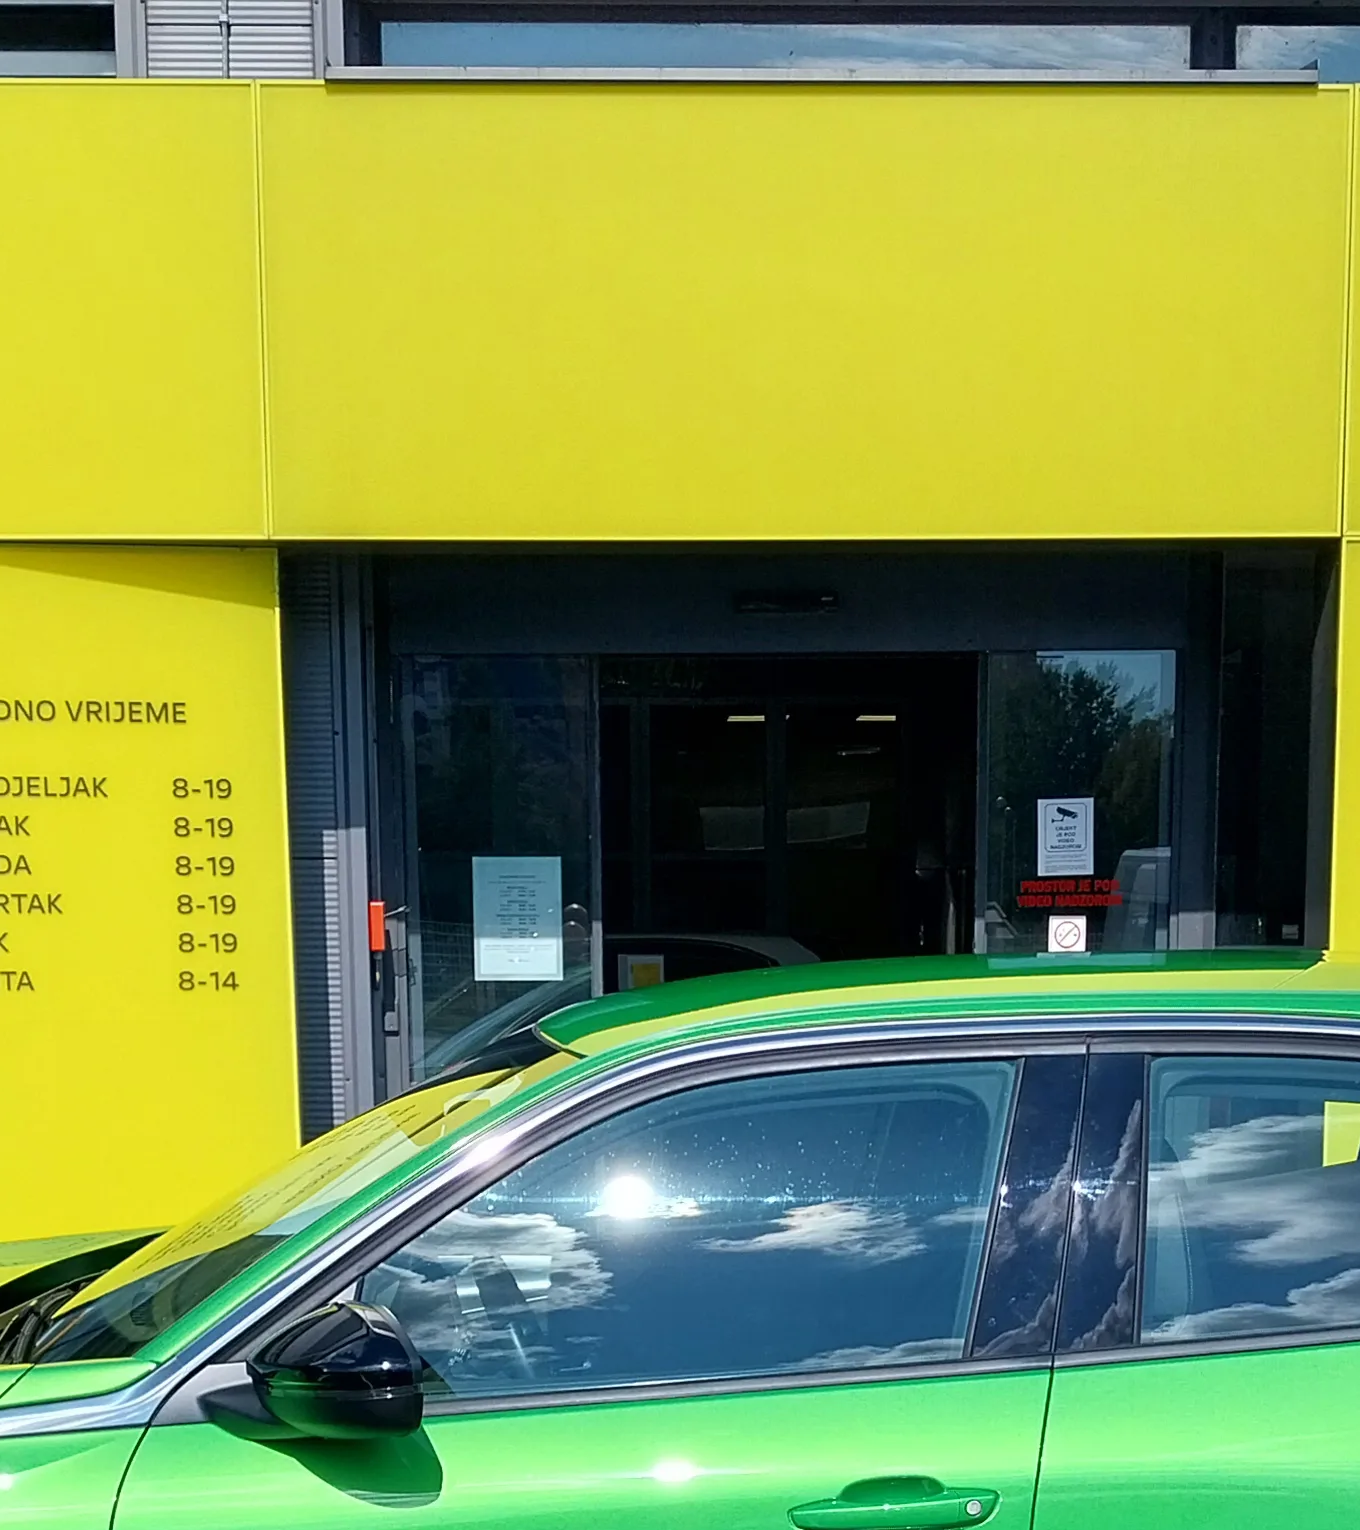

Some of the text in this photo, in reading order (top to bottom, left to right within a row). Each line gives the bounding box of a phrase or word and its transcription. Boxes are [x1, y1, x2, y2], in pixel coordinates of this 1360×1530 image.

[64, 700, 188, 724] VRIJEME
[172, 777, 233, 799] 8-19
[173, 816, 234, 838] 8-19
[175, 855, 236, 877] 8-19
[176, 893, 237, 915] 8-19
[177, 931, 238, 954] 8-19
[177, 970, 240, 992] 8-14
